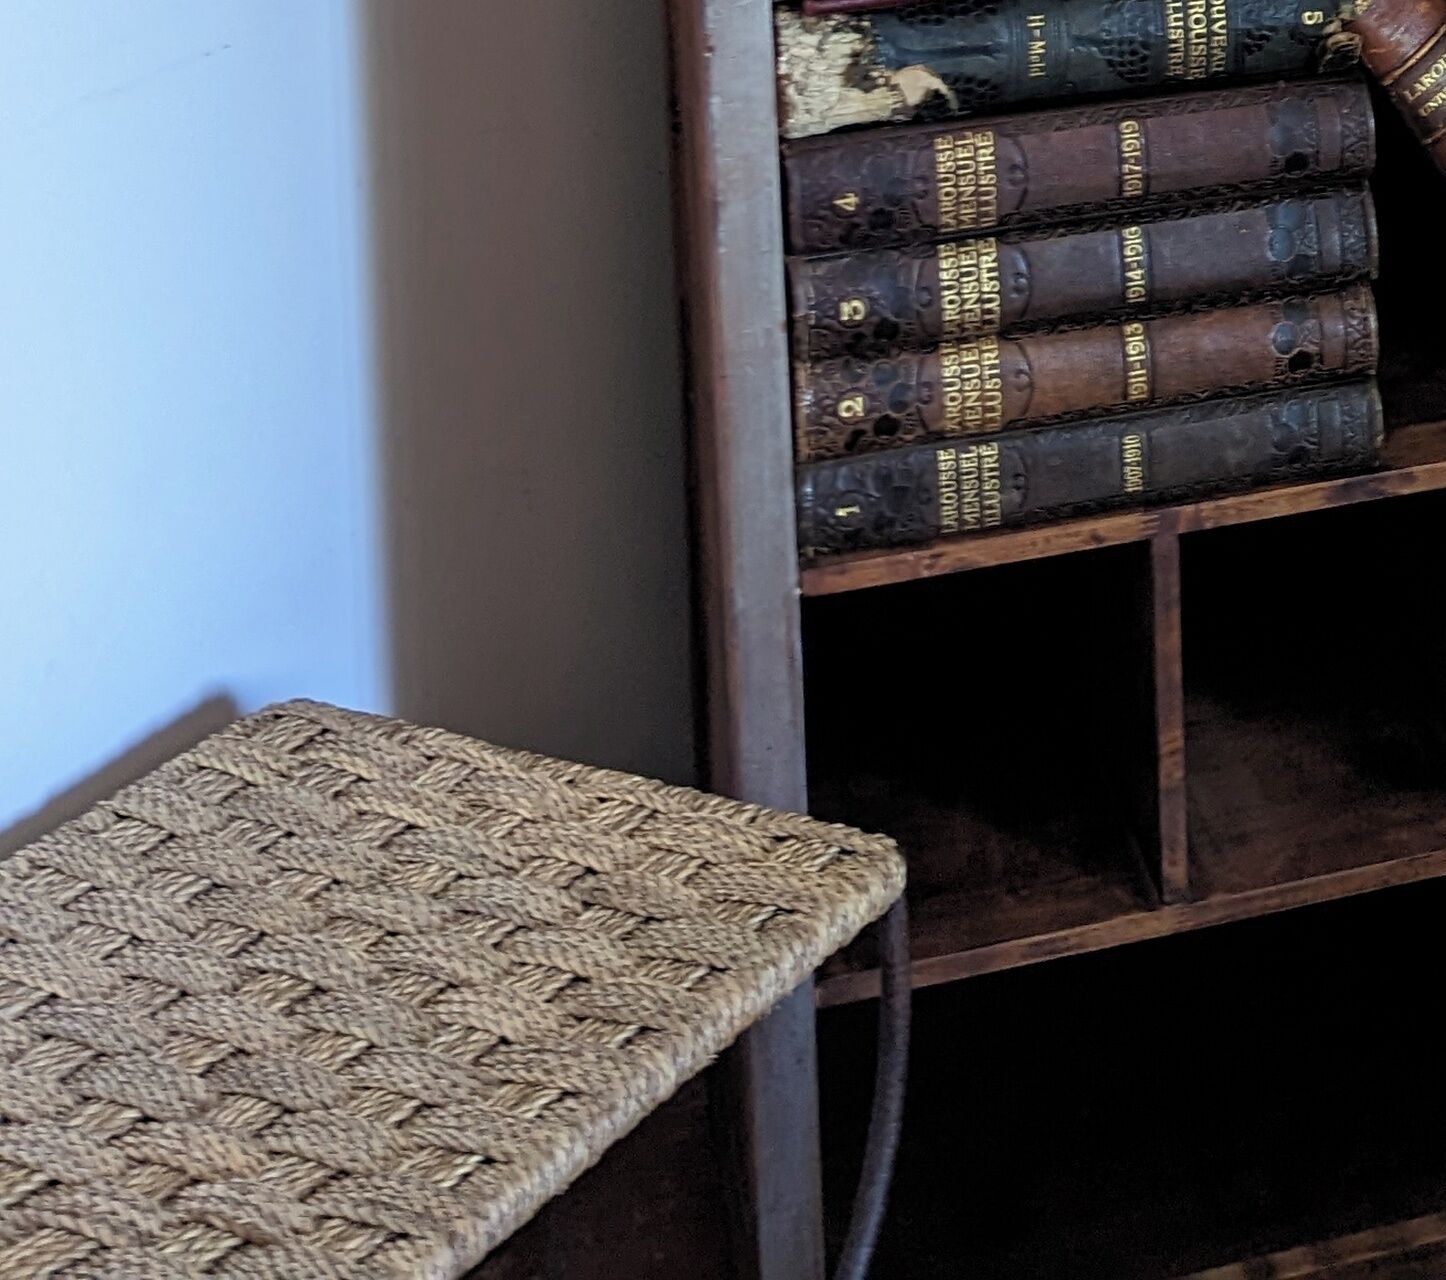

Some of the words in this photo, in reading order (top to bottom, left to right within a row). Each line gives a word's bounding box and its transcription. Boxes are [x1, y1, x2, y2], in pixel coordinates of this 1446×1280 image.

[1301, 11, 1324, 26] 5
[933, 134, 958, 233] LAROUSSE
[954, 131, 977, 230] MENSUEL
[1120, 119, 1143, 197] 1917-1919
[832, 193, 860, 211] 4
[937, 243, 960, 338] LAROUSSE
[958, 239, 980, 336] MENSUEL
[1122, 225, 1145, 303] 1914-1916
[959, 342, 982, 433] MENSUEL
[1123, 322, 1148, 400] 1911-1913
[838, 397, 865, 419] 2
[834, 505, 861, 517] 1
[936, 447, 959, 533] LAROUSSE
[957, 445, 980, 530] MENSUEL
